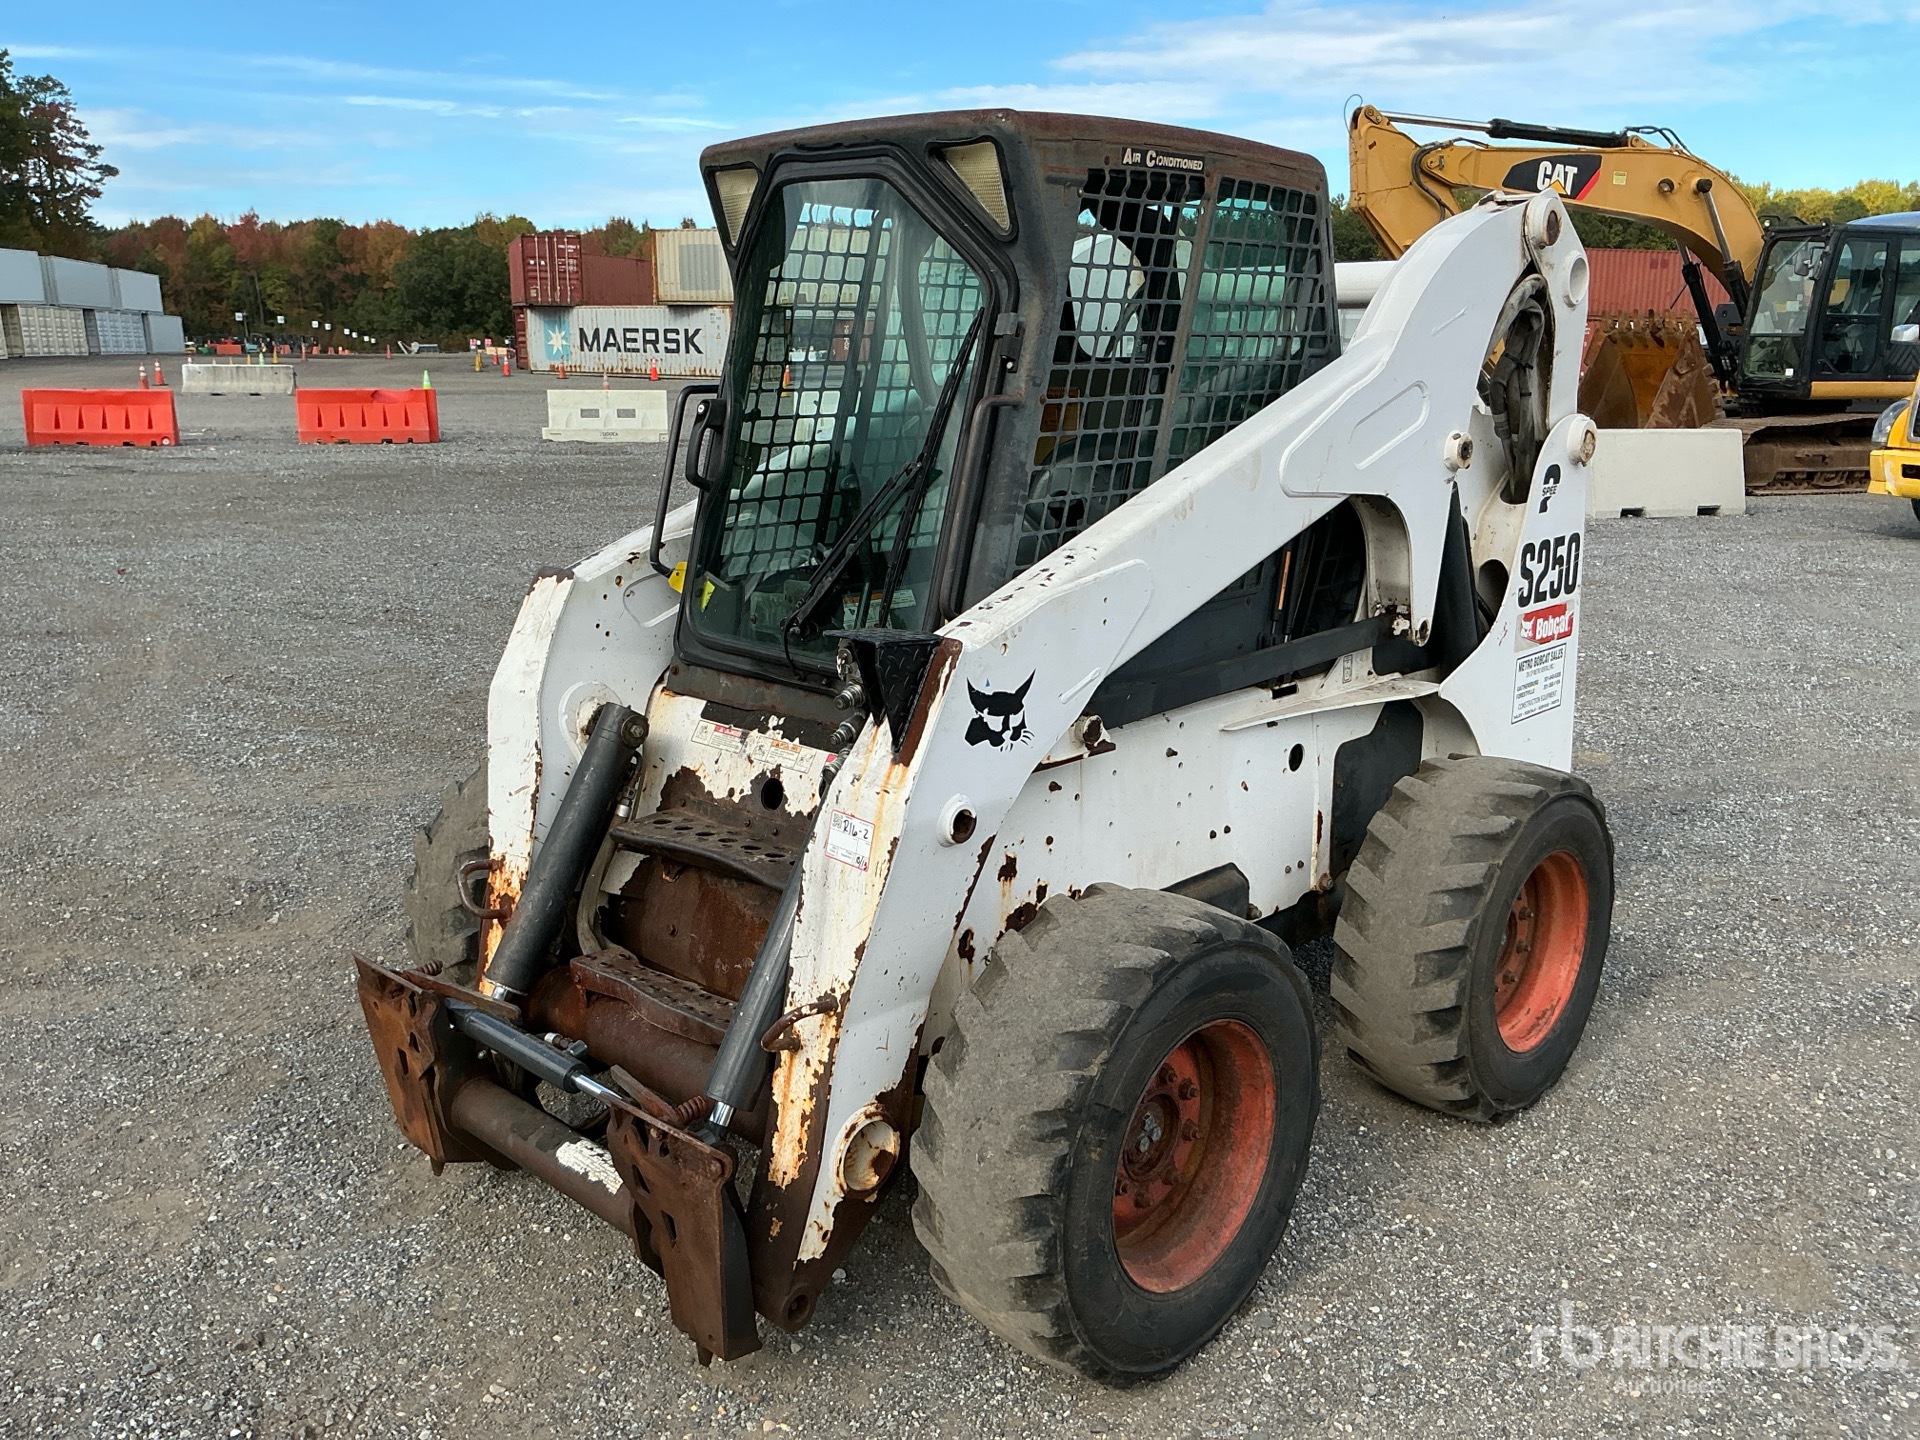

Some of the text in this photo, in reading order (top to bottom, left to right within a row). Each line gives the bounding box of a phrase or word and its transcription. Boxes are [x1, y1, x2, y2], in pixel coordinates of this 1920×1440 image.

[1122, 148, 1203, 171] AIR CONDITIONED
[1536, 160, 1578, 196] CAT
[578, 327, 704, 354] MAERSK
[1517, 532, 1581, 608] S250
[1535, 611, 1574, 642] Bobcat
[1518, 658, 1533, 673] METRO
[1533, 652, 1550, 668] BOBCAT
[1550, 648, 1563, 661] SALES
